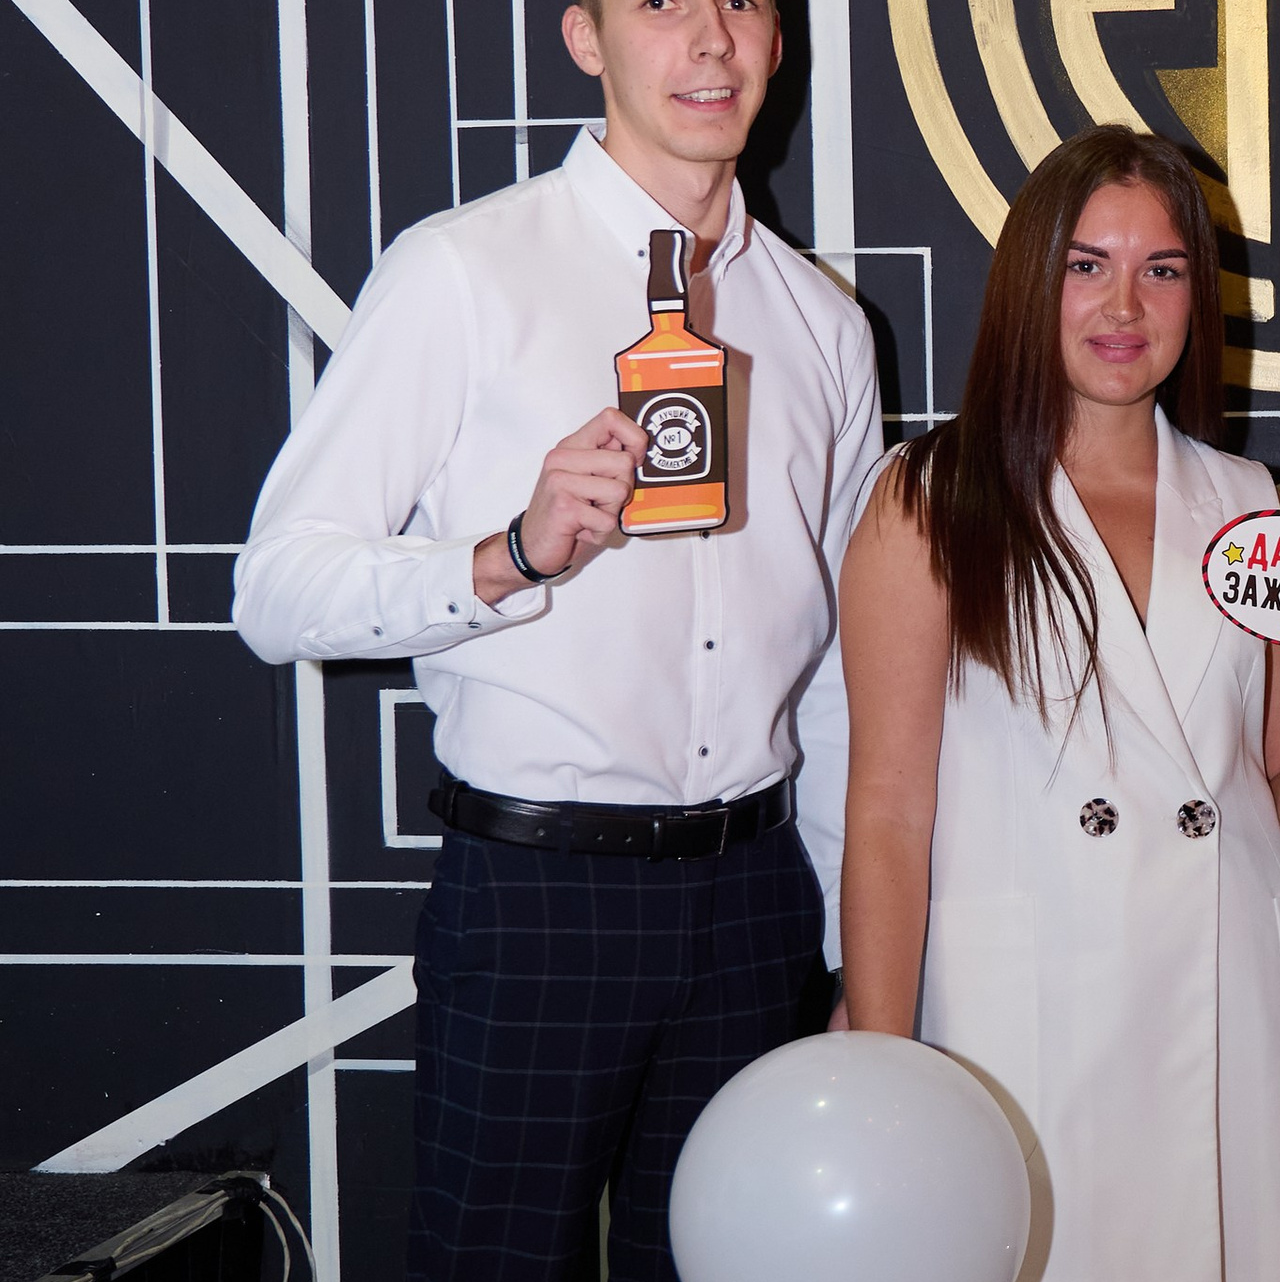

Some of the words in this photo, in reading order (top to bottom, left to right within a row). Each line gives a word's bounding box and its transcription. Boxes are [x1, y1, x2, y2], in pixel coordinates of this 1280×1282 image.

[659, 410, 689, 422] ЛУЧШИЙ
[663, 430, 681, 445] №1
[657, 456, 692, 468] КОЛЛЕКТИВ
